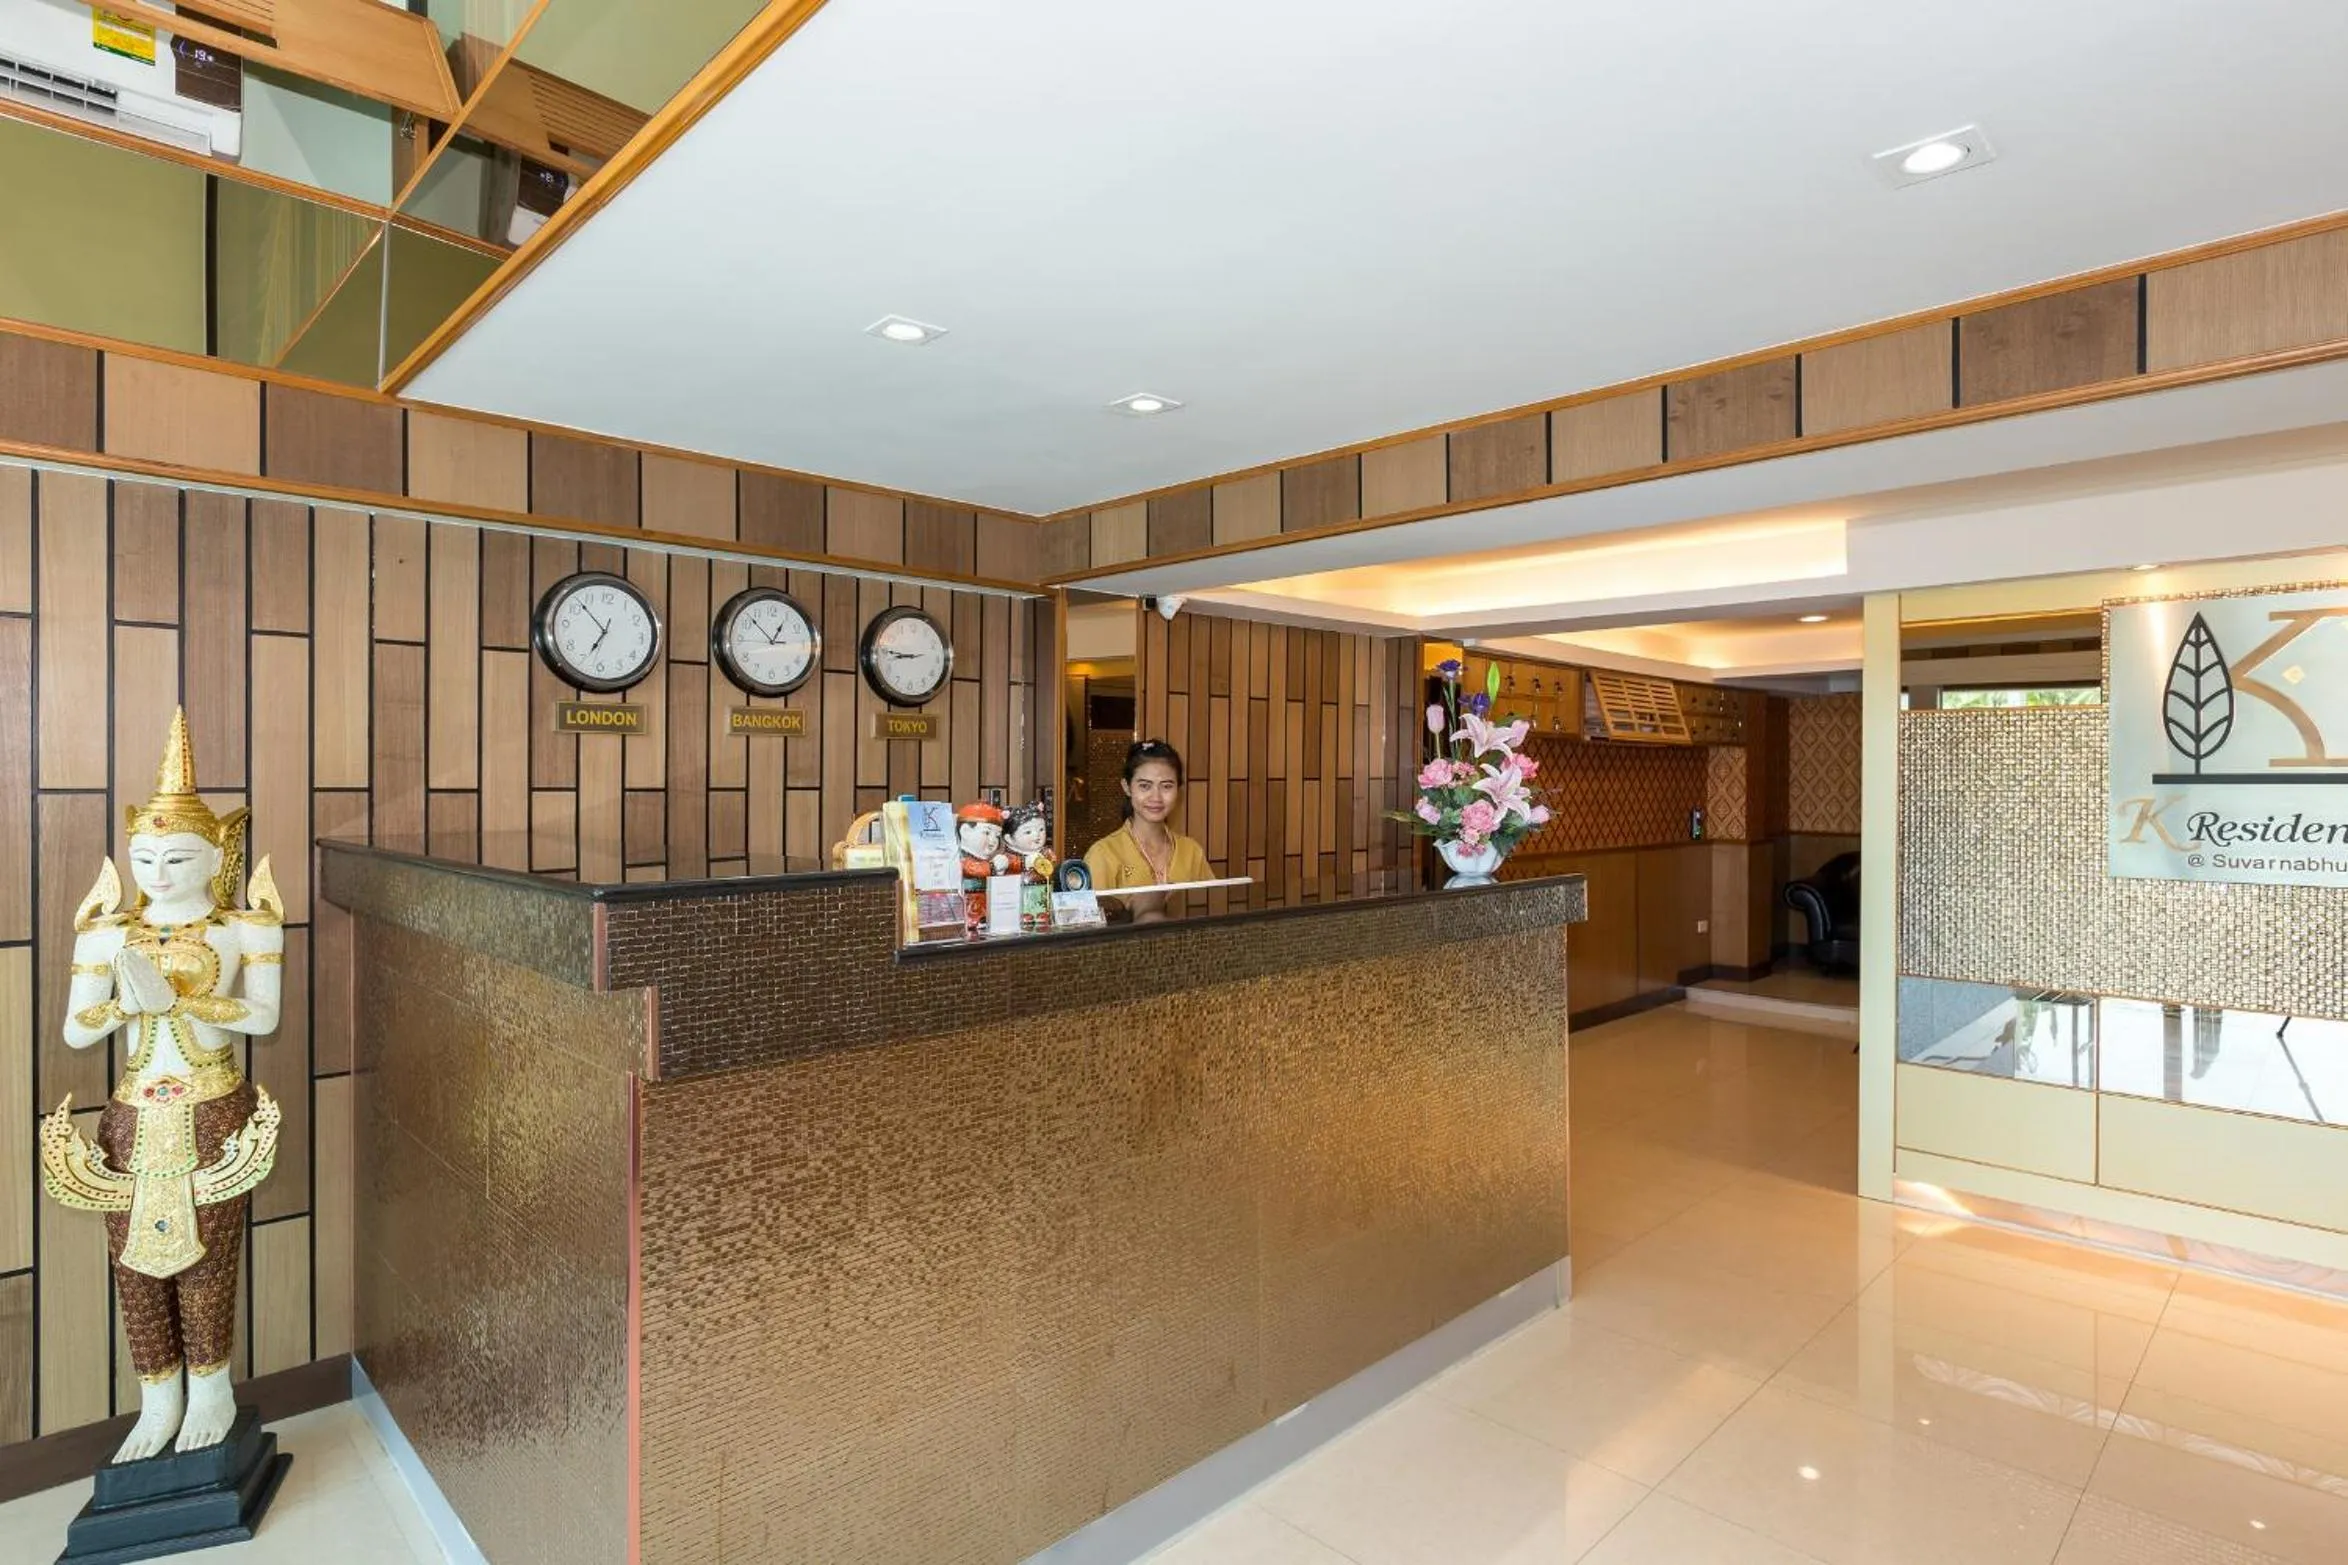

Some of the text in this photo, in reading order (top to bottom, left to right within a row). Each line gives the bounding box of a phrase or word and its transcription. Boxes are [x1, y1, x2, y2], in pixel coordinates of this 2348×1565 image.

[566, 709, 637, 726] LONDON
[732, 713, 801, 729] BANGKOK
[888, 719, 928, 733] TOKYO
[2117, 794, 2200, 852] K
[2187, 853, 2204, 868] @
